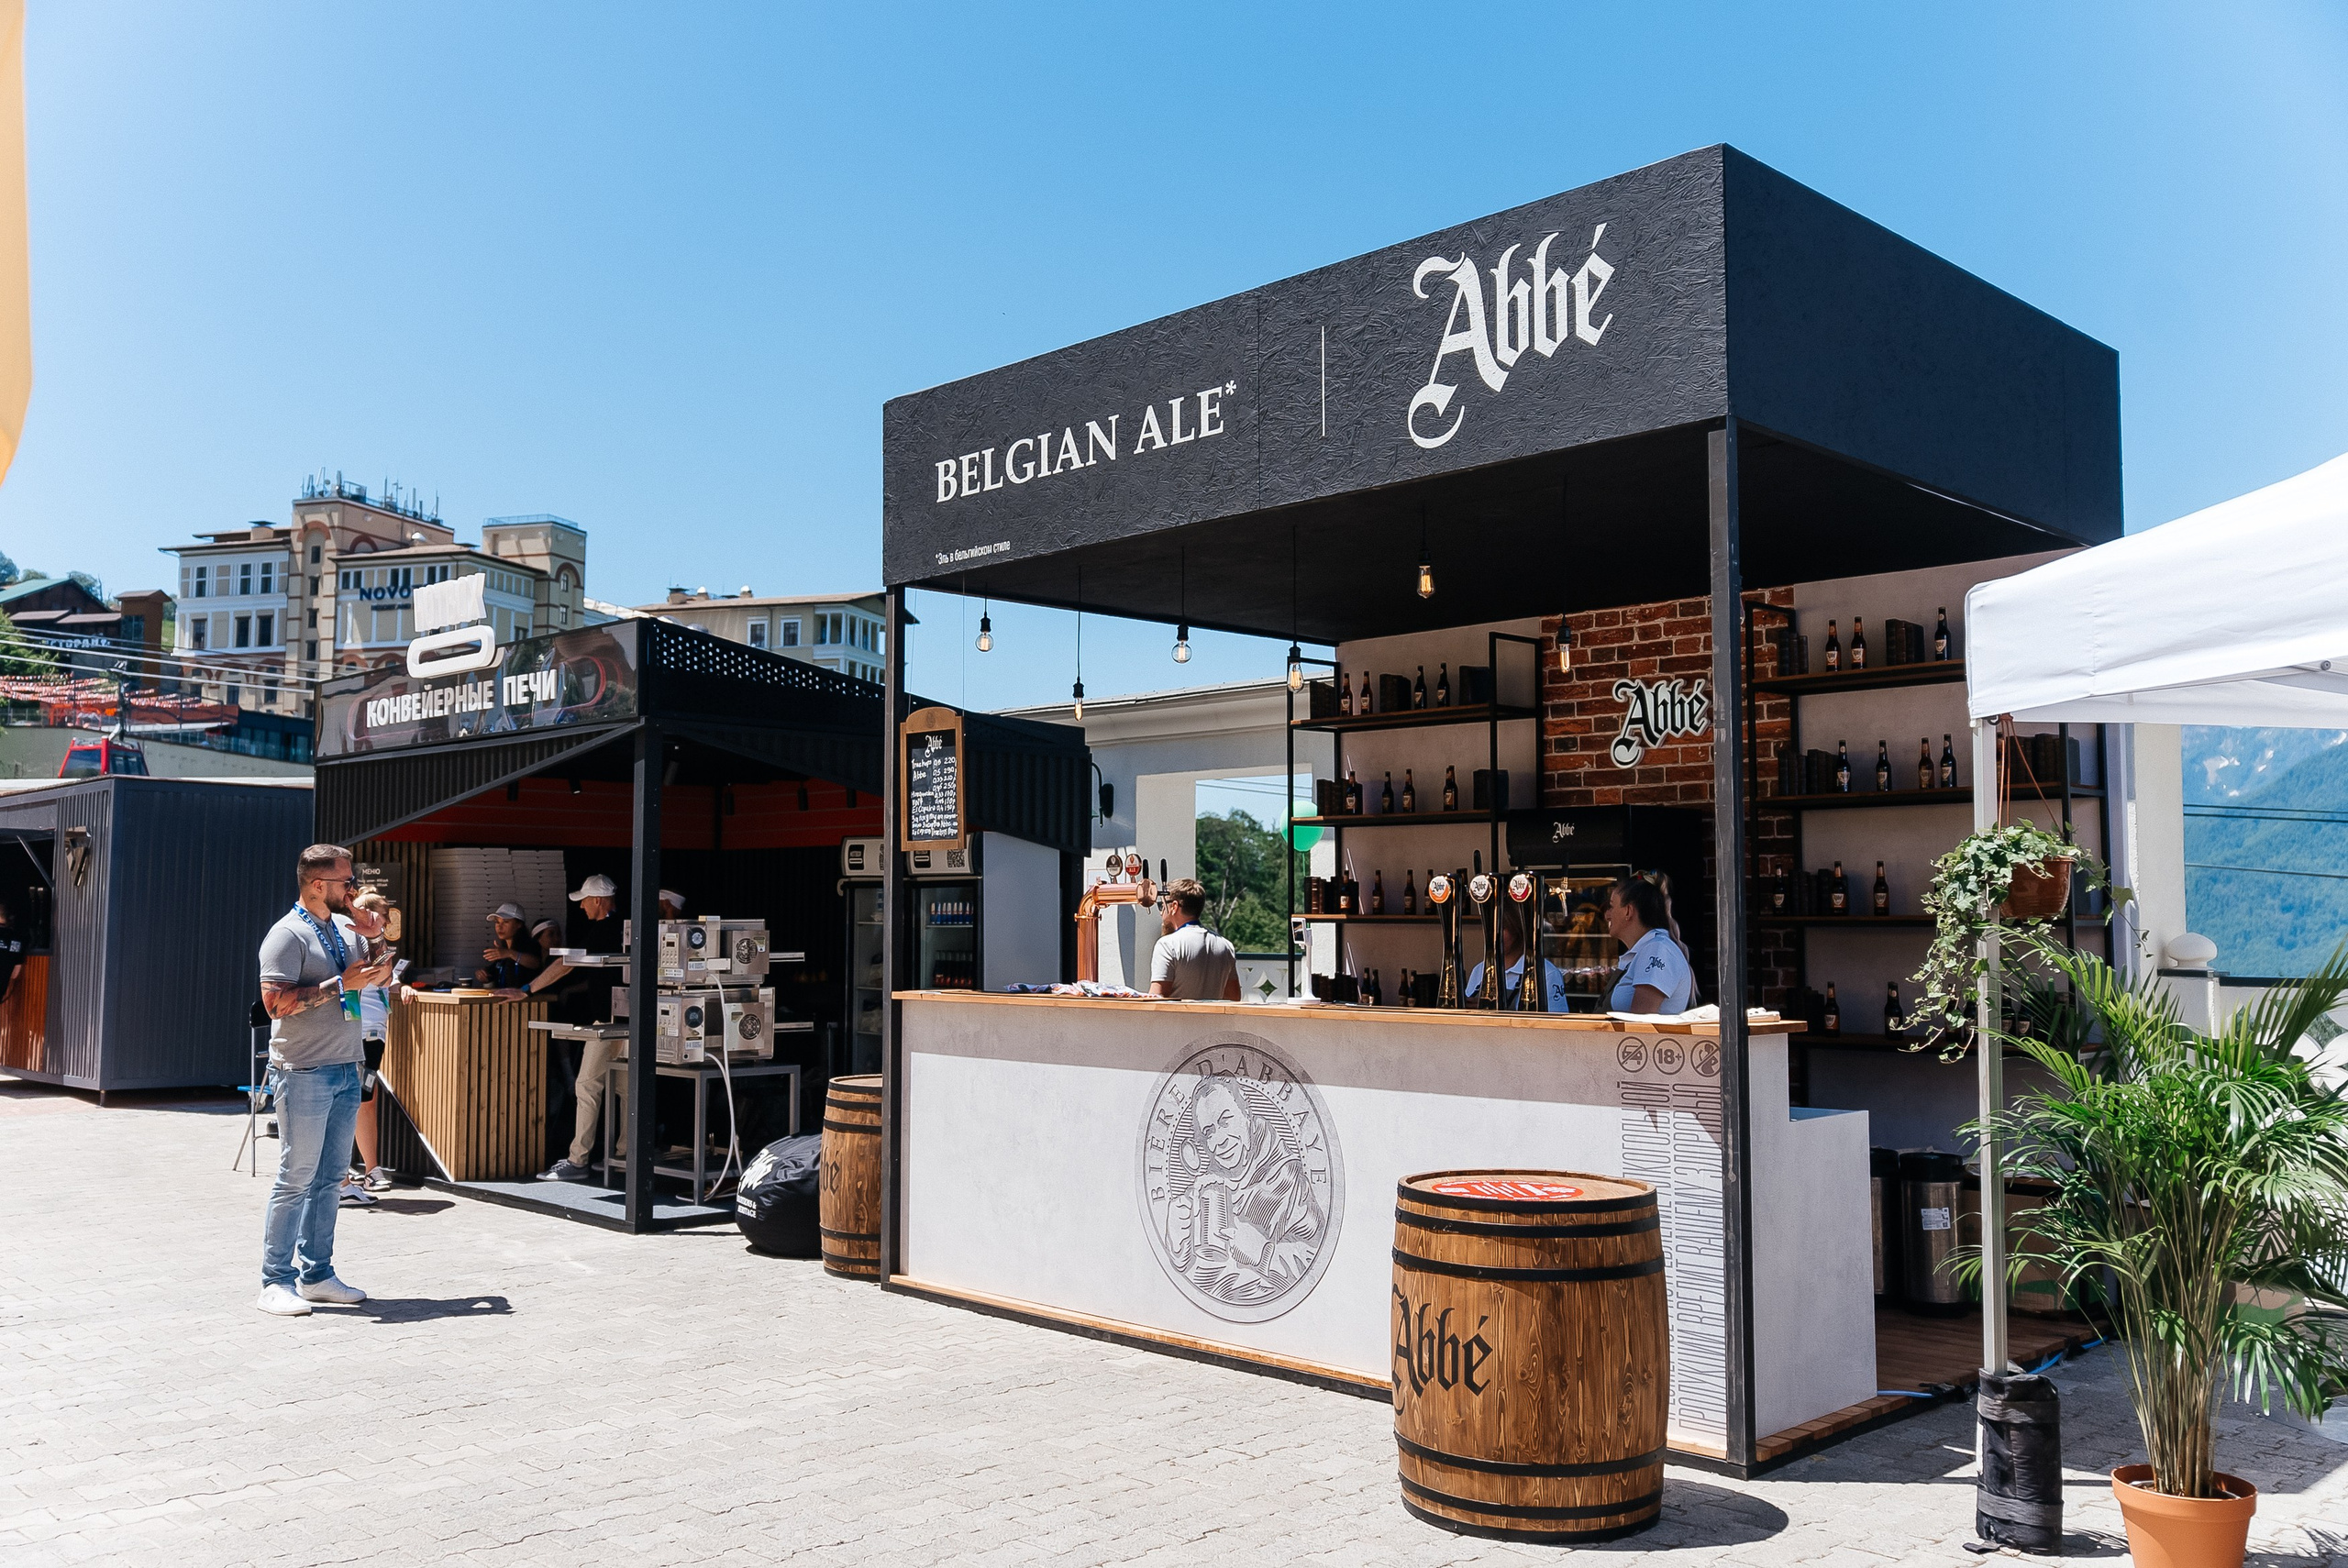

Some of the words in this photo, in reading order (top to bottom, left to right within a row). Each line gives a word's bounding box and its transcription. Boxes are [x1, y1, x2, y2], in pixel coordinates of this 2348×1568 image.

[1408, 223, 1615, 448] Abbé
[936, 414, 1119, 503] BELGIAN
[954, 545, 992, 561] бельгийском
[992, 540, 1011, 554] стиле
[360, 584, 422, 601] NOVO
[367, 679, 494, 728] КОНВЕЙЕРНЫЕ
[503, 669, 558, 706] ПЕЧИ
[1612, 680, 1709, 766] Abbé
[925, 734, 943, 757] Abbé
[1553, 822, 1575, 843] Abbé
[1656, 1048, 1682, 1065] 18+
[1617, 1081, 1671, 1196] ЛКОГОЛЬНОЙ
[1392, 1283, 1494, 1417] Abbé
